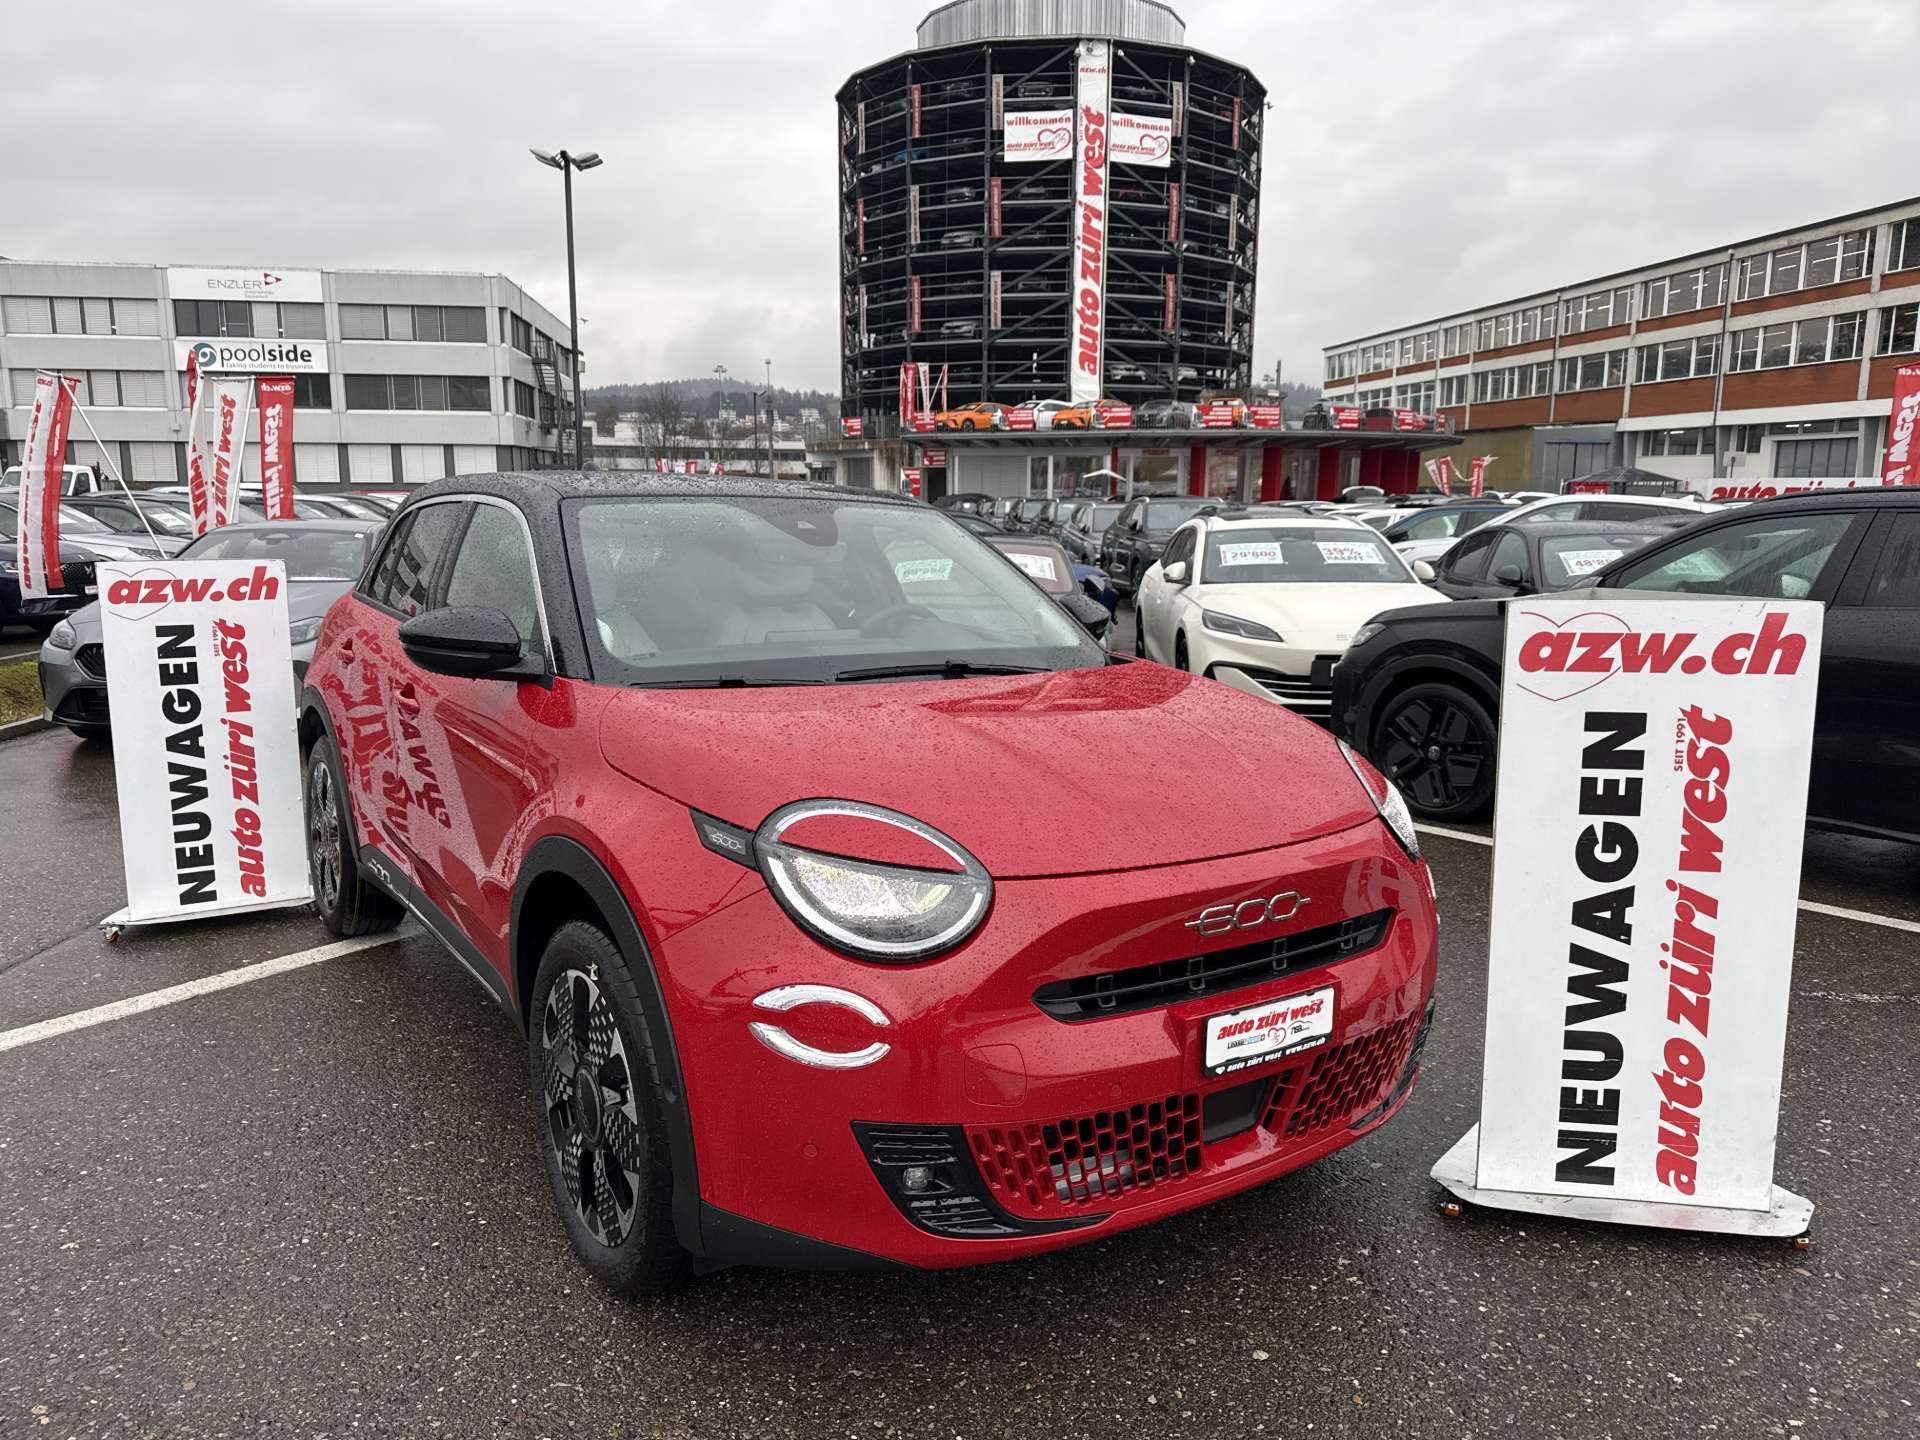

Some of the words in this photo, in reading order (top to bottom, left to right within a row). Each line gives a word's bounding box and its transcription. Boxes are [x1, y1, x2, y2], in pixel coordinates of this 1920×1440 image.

[1080, 66, 1107, 74] azw.ch
[1006, 116, 1071, 126] willkommen
[1080, 105, 1105, 196] west
[1111, 118, 1170, 132] willkommen
[1076, 199, 1102, 287] züri
[208, 279, 262, 289] ENZLER
[220, 344, 312, 368] poolside
[1078, 285, 1100, 376] auto
[218, 393, 236, 453] west
[107, 566, 279, 604] azw.ch
[212, 618, 252, 713] west
[1519, 613, 1807, 676] azw.ch
[1674, 749, 1684, 772] SEIT
[1676, 718, 1686, 744] 1991
[155, 624, 218, 906] NEUWAGEN
[219, 718, 260, 806] züri
[1679, 704, 1733, 872] west
[230, 808, 266, 898] auto
[1192, 891, 1306, 936] 600
[1555, 711, 1648, 1186] NEUWAGEN
[1659, 879, 1719, 1038] züri
[1217, 1019, 1254, 1040] auto
[1256, 1007, 1289, 1030] züri
[1291, 999, 1324, 1021] west
[1227, 1062, 1245, 1072] auto
[1265, 1050, 1282, 1062] west
[1649, 1038, 1708, 1196] auto
